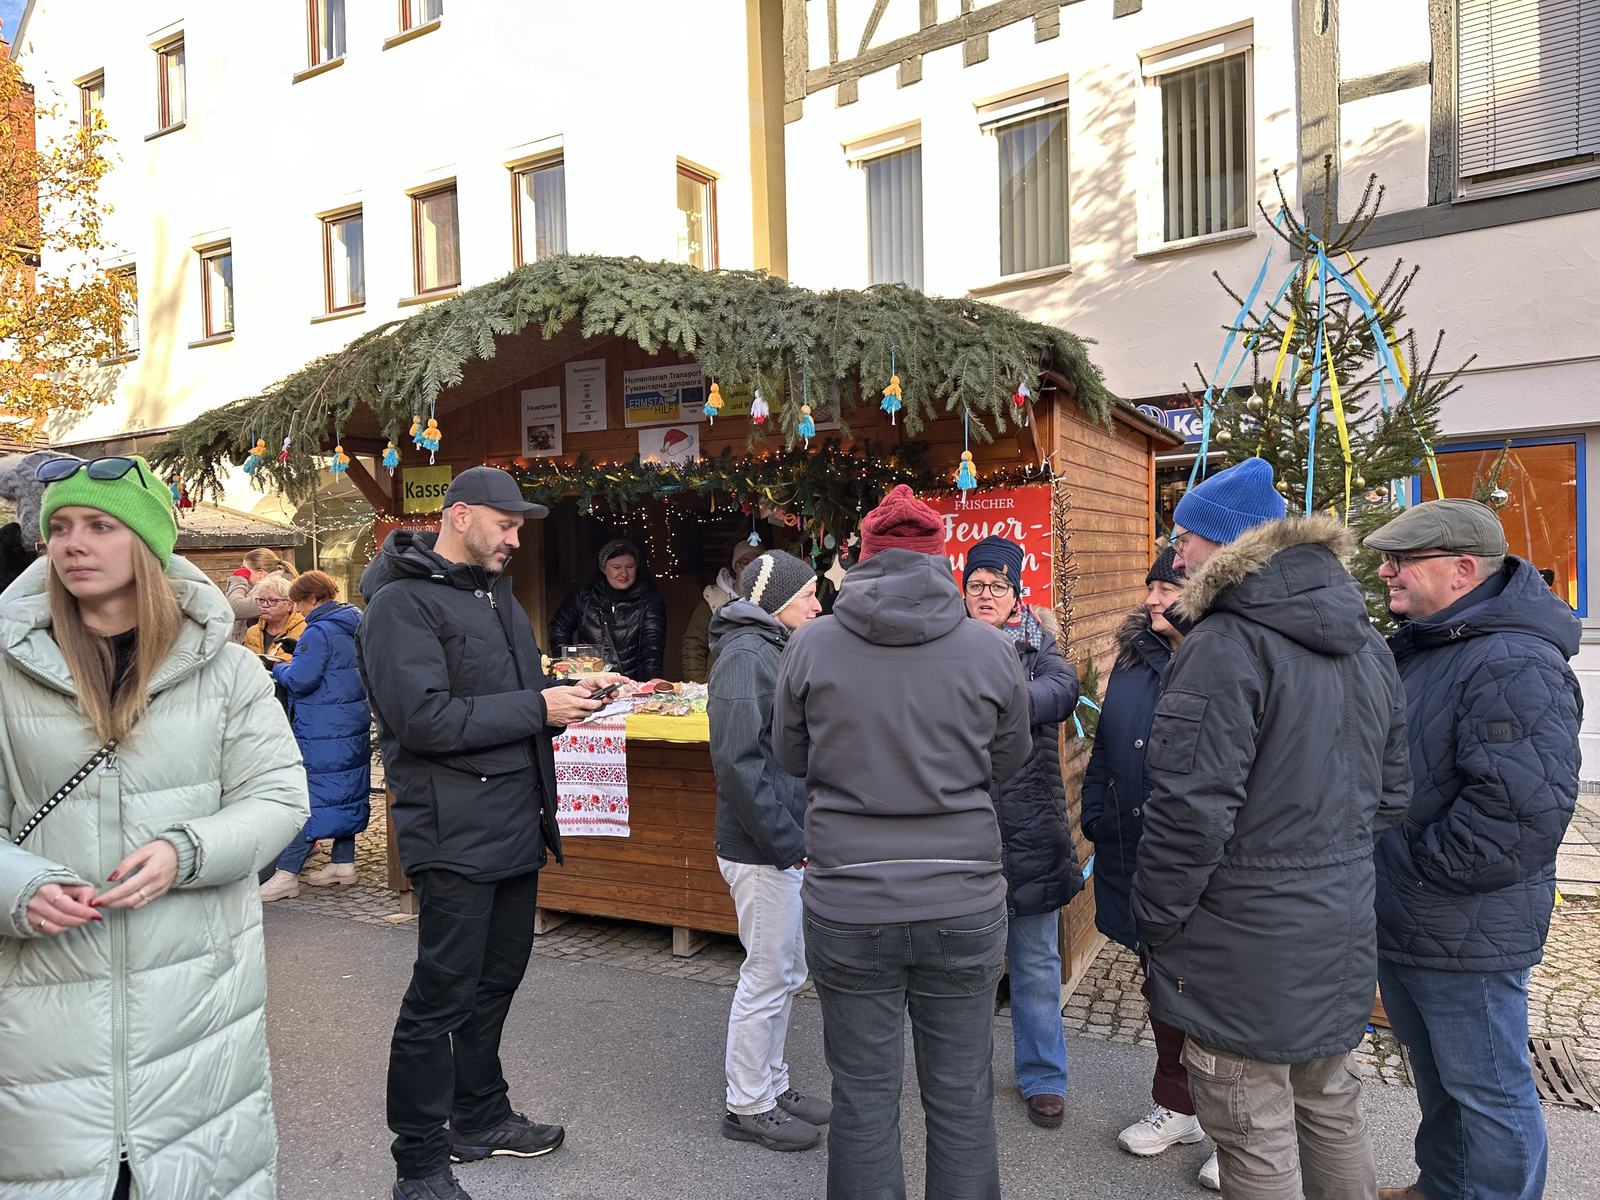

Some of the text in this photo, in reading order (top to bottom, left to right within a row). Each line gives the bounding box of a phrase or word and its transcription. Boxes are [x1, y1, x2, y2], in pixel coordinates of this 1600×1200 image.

[625, 370, 702, 384] Humanitarian Transport
[625, 379, 702, 393] Гуманітарна допомога
[405, 481, 450, 499] Kasse
[954, 498, 1015, 511] FRISCHER
